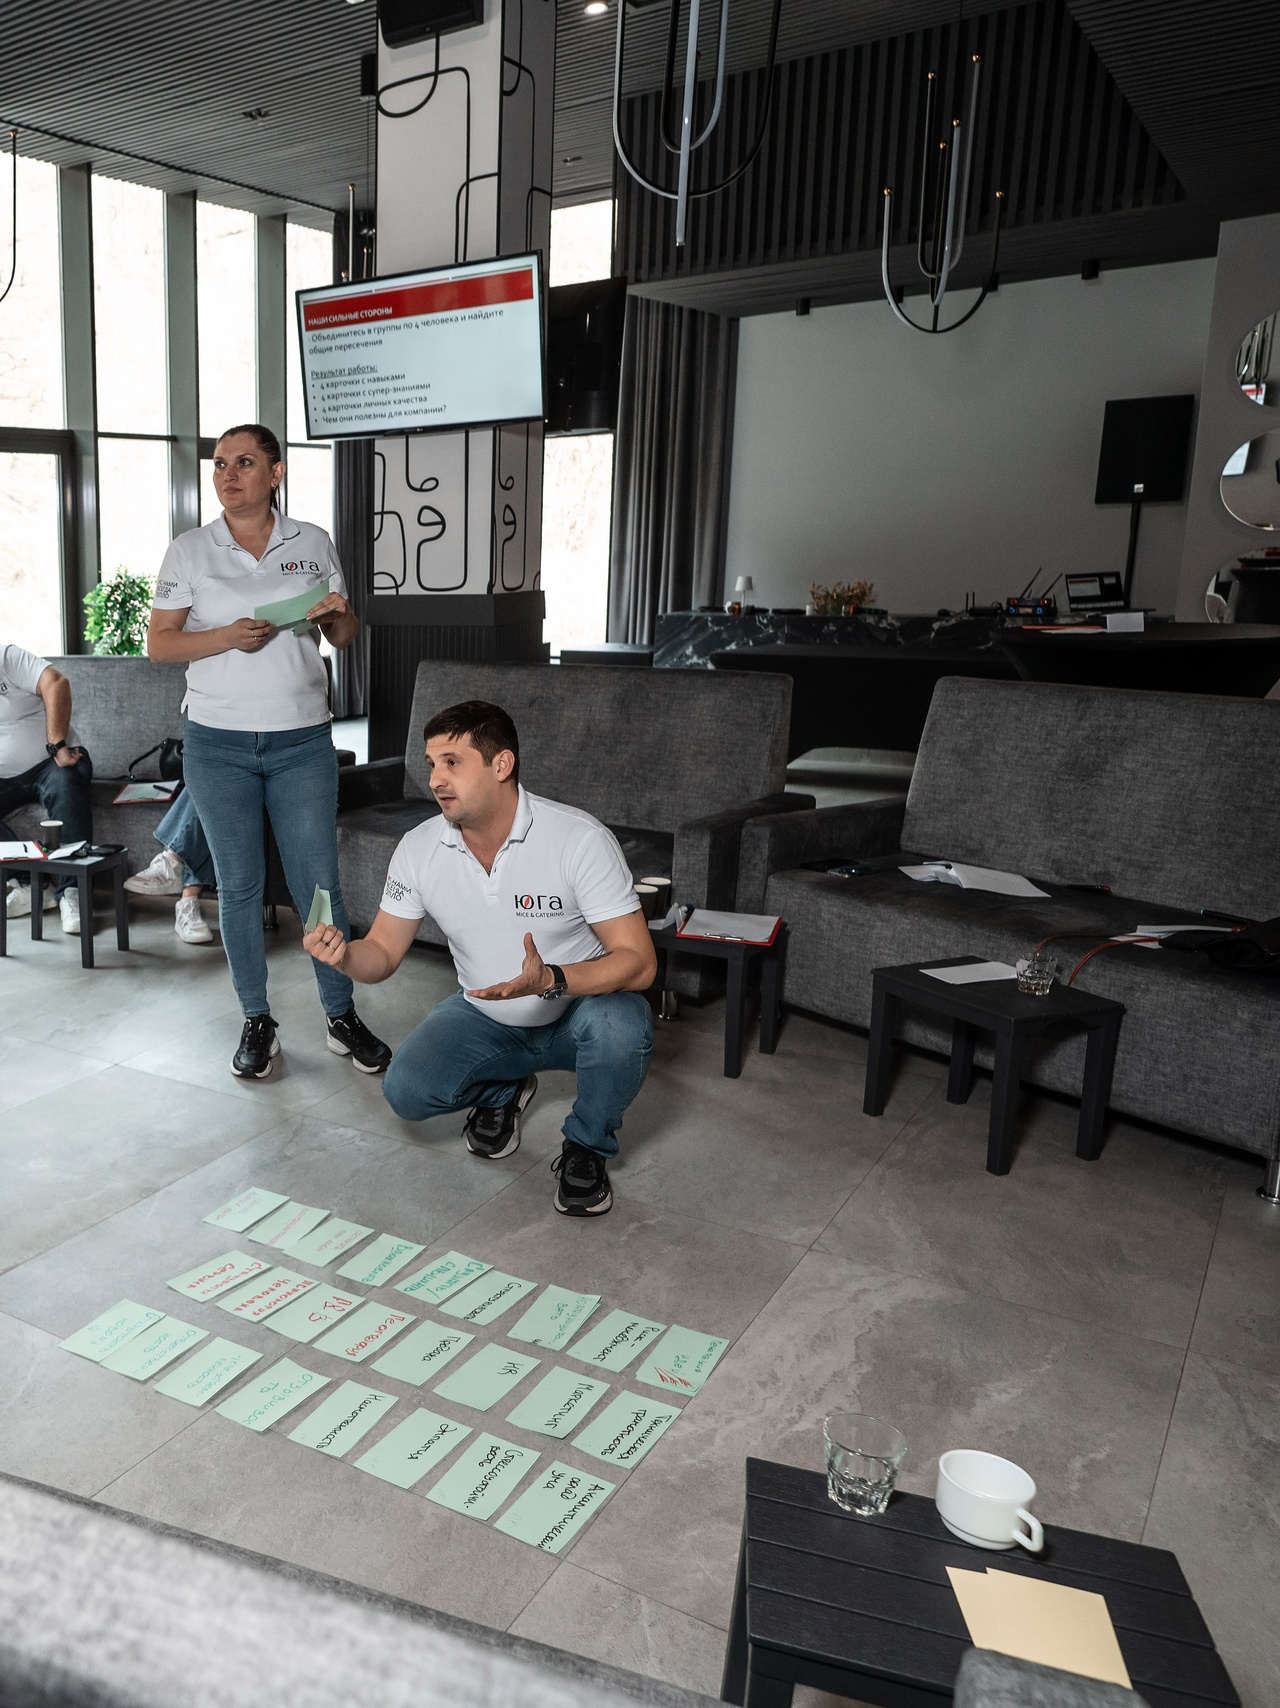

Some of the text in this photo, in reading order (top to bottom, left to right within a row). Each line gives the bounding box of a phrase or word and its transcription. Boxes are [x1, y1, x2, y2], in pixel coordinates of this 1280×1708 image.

[312, 329, 365, 343] Объединитесь
[374, 323, 401, 336] группы
[415, 321, 419, 330] 4
[421, 315, 459, 328] человека
[468, 308, 504, 321] найдите
[309, 338, 382, 355] общие пересечения
[311, 363, 377, 378] Результат работы:
[326, 378, 359, 391] карточки
[368, 373, 405, 383] навыками
[327, 389, 361, 402] карточки
[368, 382, 431, 399] супер-знаниями
[328, 401, 361, 413] карточки
[364, 399, 391, 409] личных
[393, 395, 427, 406] качества
[323, 416, 337, 424] Чем
[355, 412, 387, 421] полезны
[389, 409, 402, 419] для
[404, 405, 446, 417] компании?
[280, 560, 320, 572] юга
[515, 894, 563, 910] юга
[545, 1383, 593, 1428] Маркетинг
[543, 1468, 565, 1489] ума
